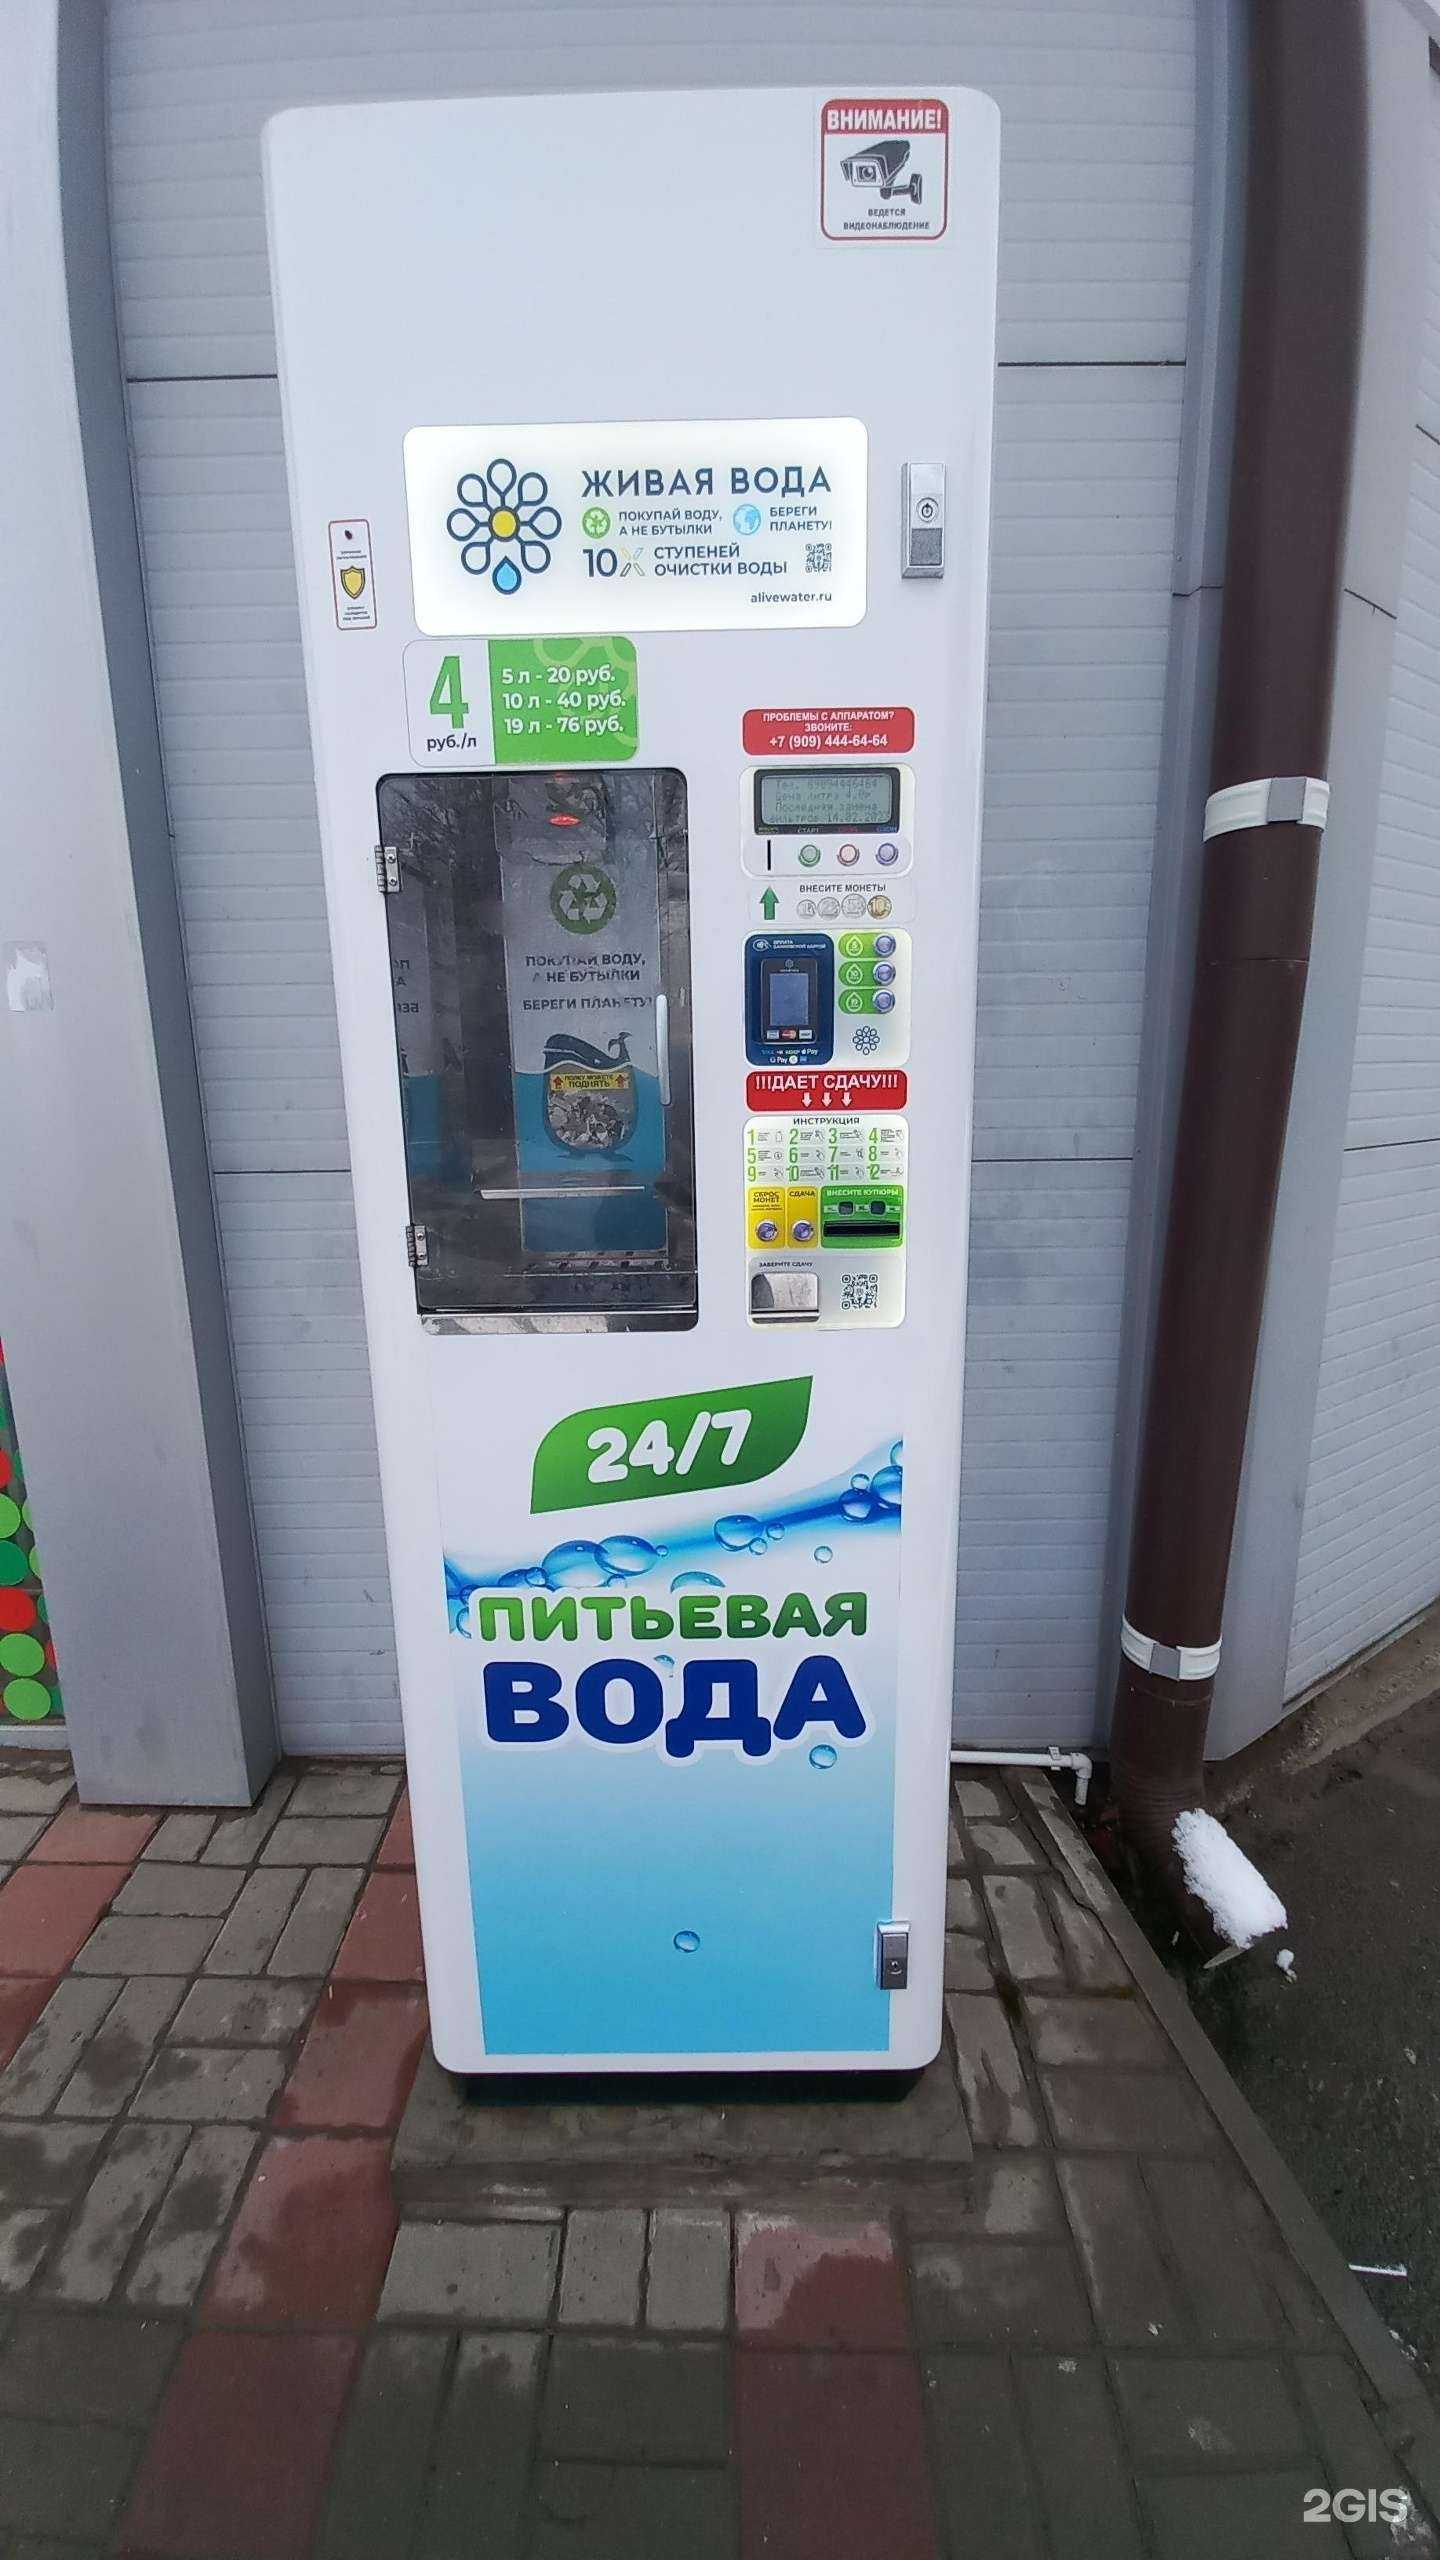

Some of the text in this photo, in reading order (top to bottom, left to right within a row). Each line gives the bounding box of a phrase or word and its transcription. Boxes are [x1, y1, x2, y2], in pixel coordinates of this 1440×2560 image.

[827, 109, 941, 130] ВНИМАНИЕ!
[868, 208, 906, 217] ВЕДЕТСЯ
[843, 221, 930, 231] ВИДЕОНАБЛЮДЕНИЕ
[581, 466, 831, 498] ЖИВАЯ ВОДА
[619, 508, 722, 522] ПОКУПАЙ ВОДУ,
[769, 506, 818, 517] БЕРЕГИ
[619, 524, 712, 536] А НЕ БУТЫЛКИ
[769, 520, 833, 532] ПЛАНЕТУ!
[654, 542, 740, 560] СТУПЕНЕЙ
[654, 561, 788, 577] ОЧИСТКИ ВОДЫ
[751, 592, 832, 604] alivewater.ru
[502, 669, 514, 685] 5
[518, 670, 530, 684] л
[547, 667, 572, 684] 20
[575, 664, 616, 686] руб.
[429, 656, 469, 729] 4
[503, 694, 523, 710] 10
[527, 695, 540, 709] л
[557, 692, 582, 708] 40
[587, 691, 626, 711] руб.
[763, 711, 895, 722] ПРОБЛЕМЫ С АППАРАТОМ?
[504, 718, 524, 734] 19
[528, 720, 541, 734] л
[557, 717, 580, 733] 76
[585, 715, 624, 736] руб.
[804, 722, 853, 732] ЗВОНИТЕ:
[427, 733, 477, 751] руб./л
[769, 734, 889, 749] +7 (909) 444-64-64
[799, 884, 886, 893] ВНЕСИТЕ МОНЕТЫ
[602, 953, 646, 966] ВОДУ,
[546, 971, 565, 983] НЕ
[569, 970, 640, 982] БУТЫЛКИ
[523, 998, 577, 1011] БЕРЕГИ
[755, 1074, 898, 1092] !!!ДАЕТ СДАЧУ!!!
[793, 1117, 860, 1125] ИНСТРУКЦИЯ
[747, 1129, 754, 1145] 1
[790, 1128, 799, 1144] 2
[829, 1127, 838, 1144] 3
[869, 1128, 879, 1143] 4
[747, 1148, 756, 1164] 5
[790, 1147, 798, 1163] 6
[828, 1146, 838, 1162] 7
[868, 1145, 877, 1161] 8
[747, 1166, 756, 1182] 9
[786, 1165, 799, 1181] 10
[827, 1164, 839, 1180] 11
[867, 1164, 880, 1180] 12
[587, 1409, 752, 1484] 24/7
[478, 1591, 868, 1642] ПИТЬЕВАЯ
[482, 1654, 867, 1759] ВОДА
